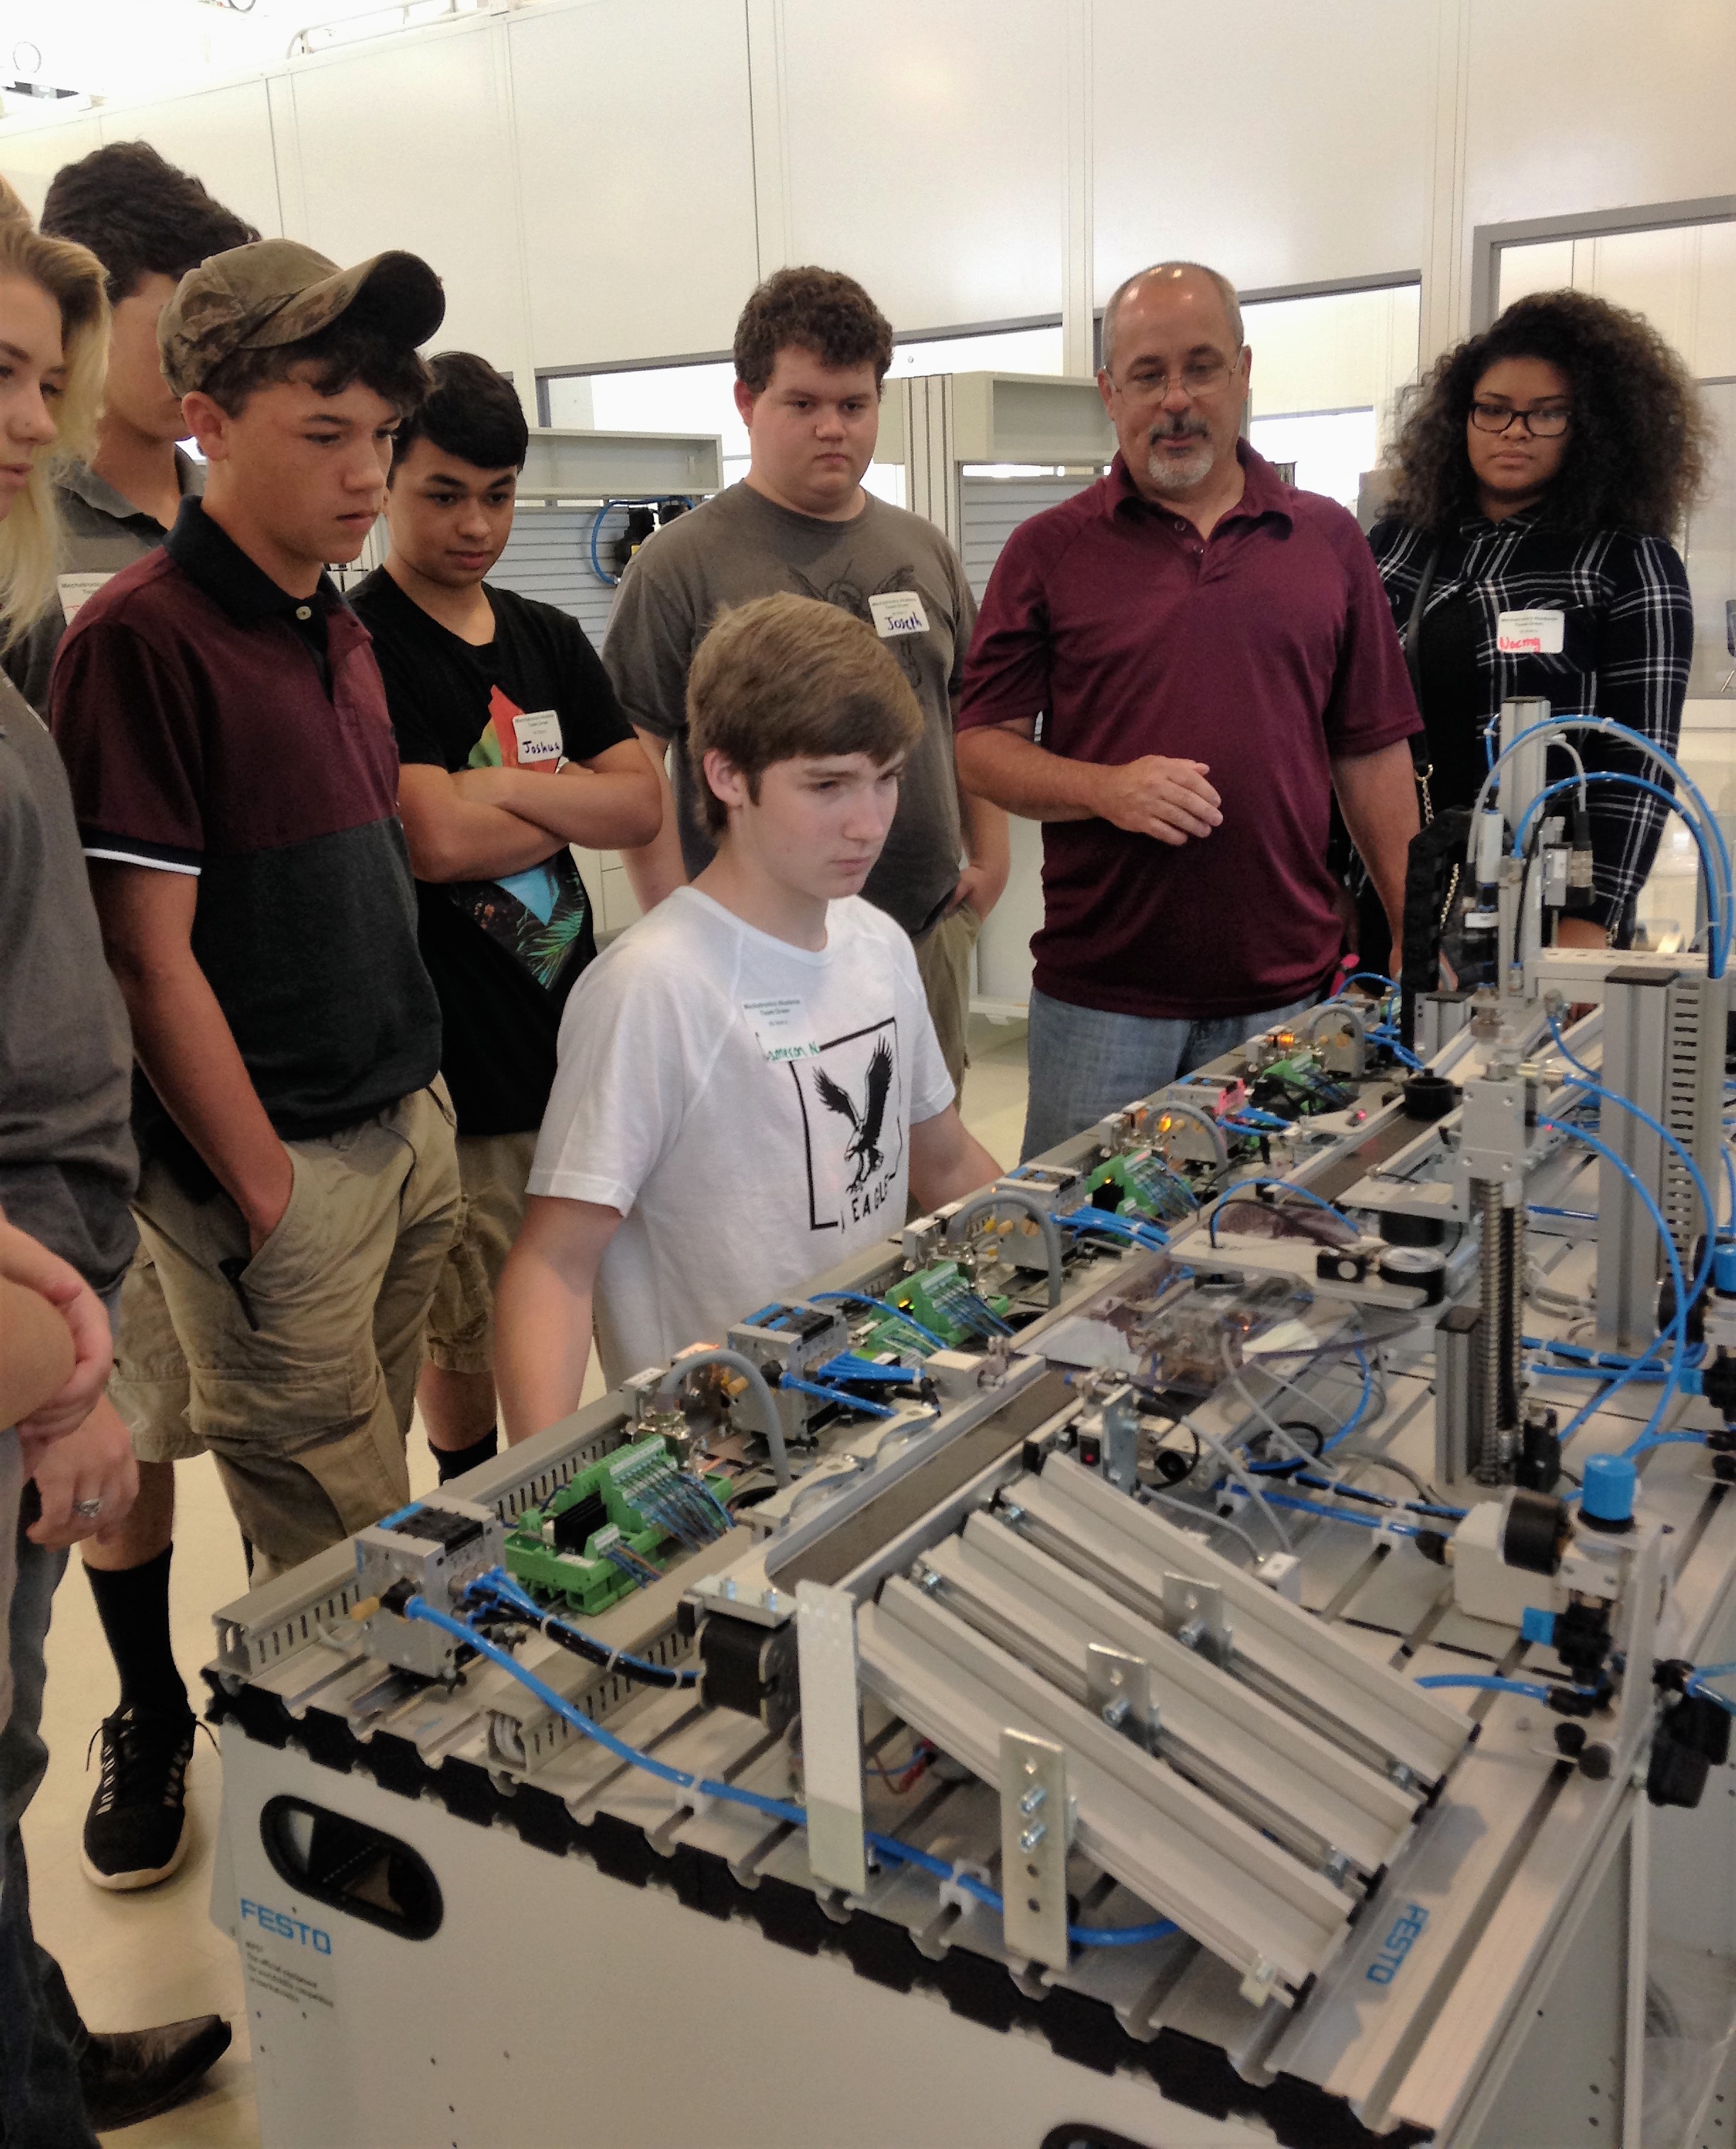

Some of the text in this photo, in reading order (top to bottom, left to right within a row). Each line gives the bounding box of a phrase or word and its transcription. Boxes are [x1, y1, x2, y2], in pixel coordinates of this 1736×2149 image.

[522, 740, 559, 753] Joshua
[240, 1897, 331, 1955] FESTO
[1366, 1904, 1430, 1984] FESTO
